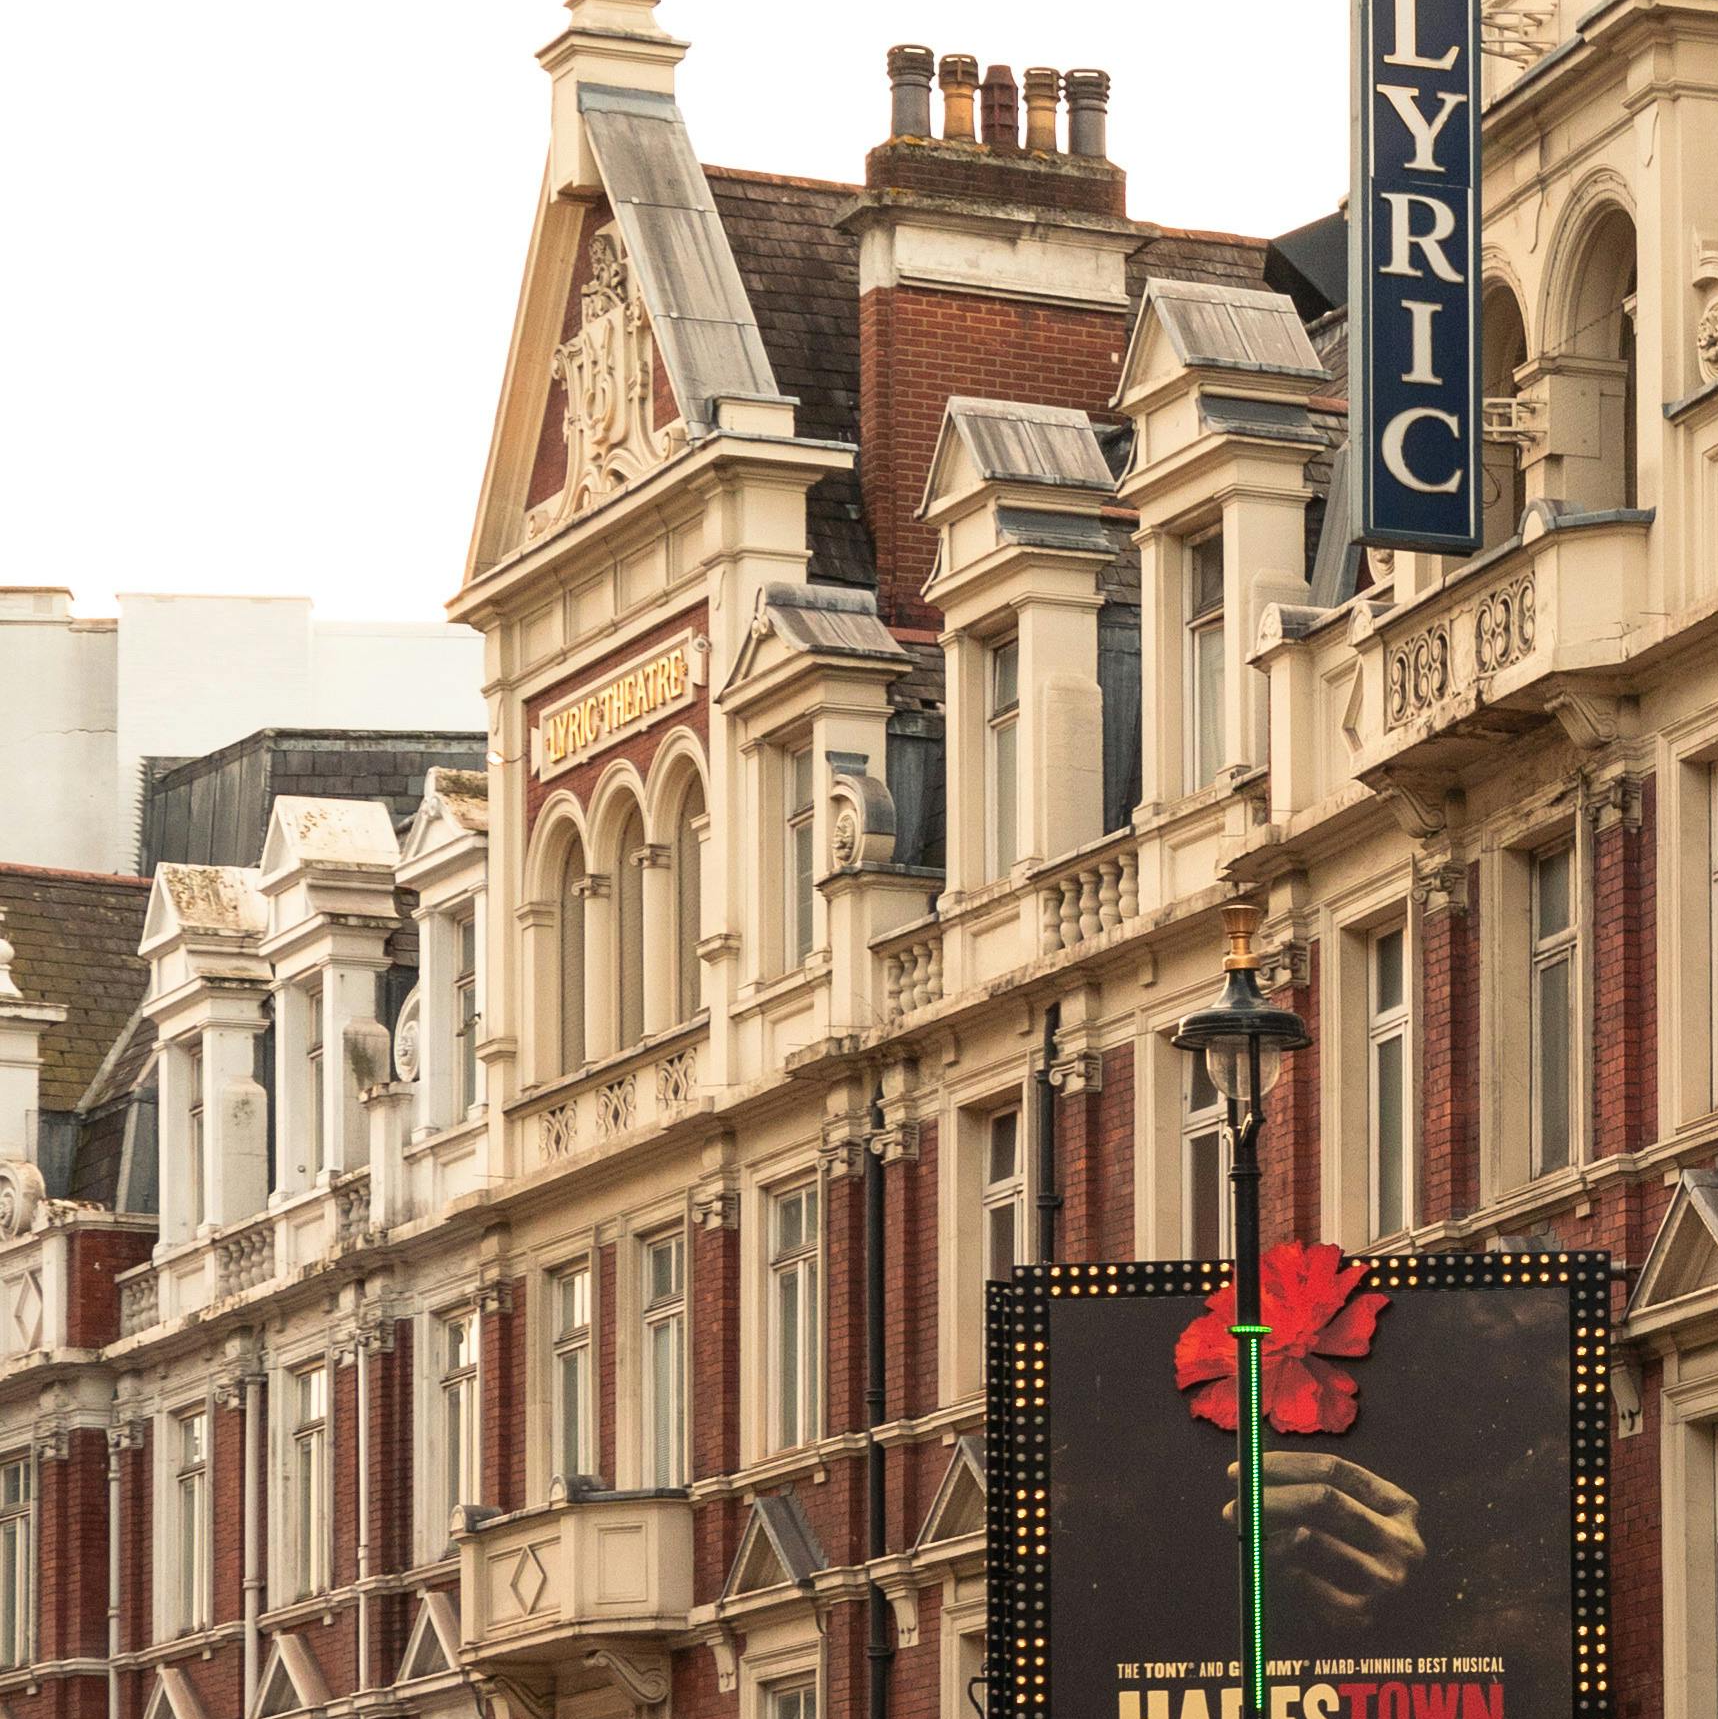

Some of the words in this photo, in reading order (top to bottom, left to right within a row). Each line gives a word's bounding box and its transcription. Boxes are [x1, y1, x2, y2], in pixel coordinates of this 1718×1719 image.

[549, 696, 599, 764] LYRIC
[601, 648, 684, 734] THEATRE
[1117, 1663, 1140, 1679] THE
[1199, 1661, 1224, 1678] AND
[1314, 1656, 1413, 1676] AWARD-WINNING
[1417, 1656, 1449, 1674] BEST
[1452, 1655, 1506, 1673] MUSICAL
